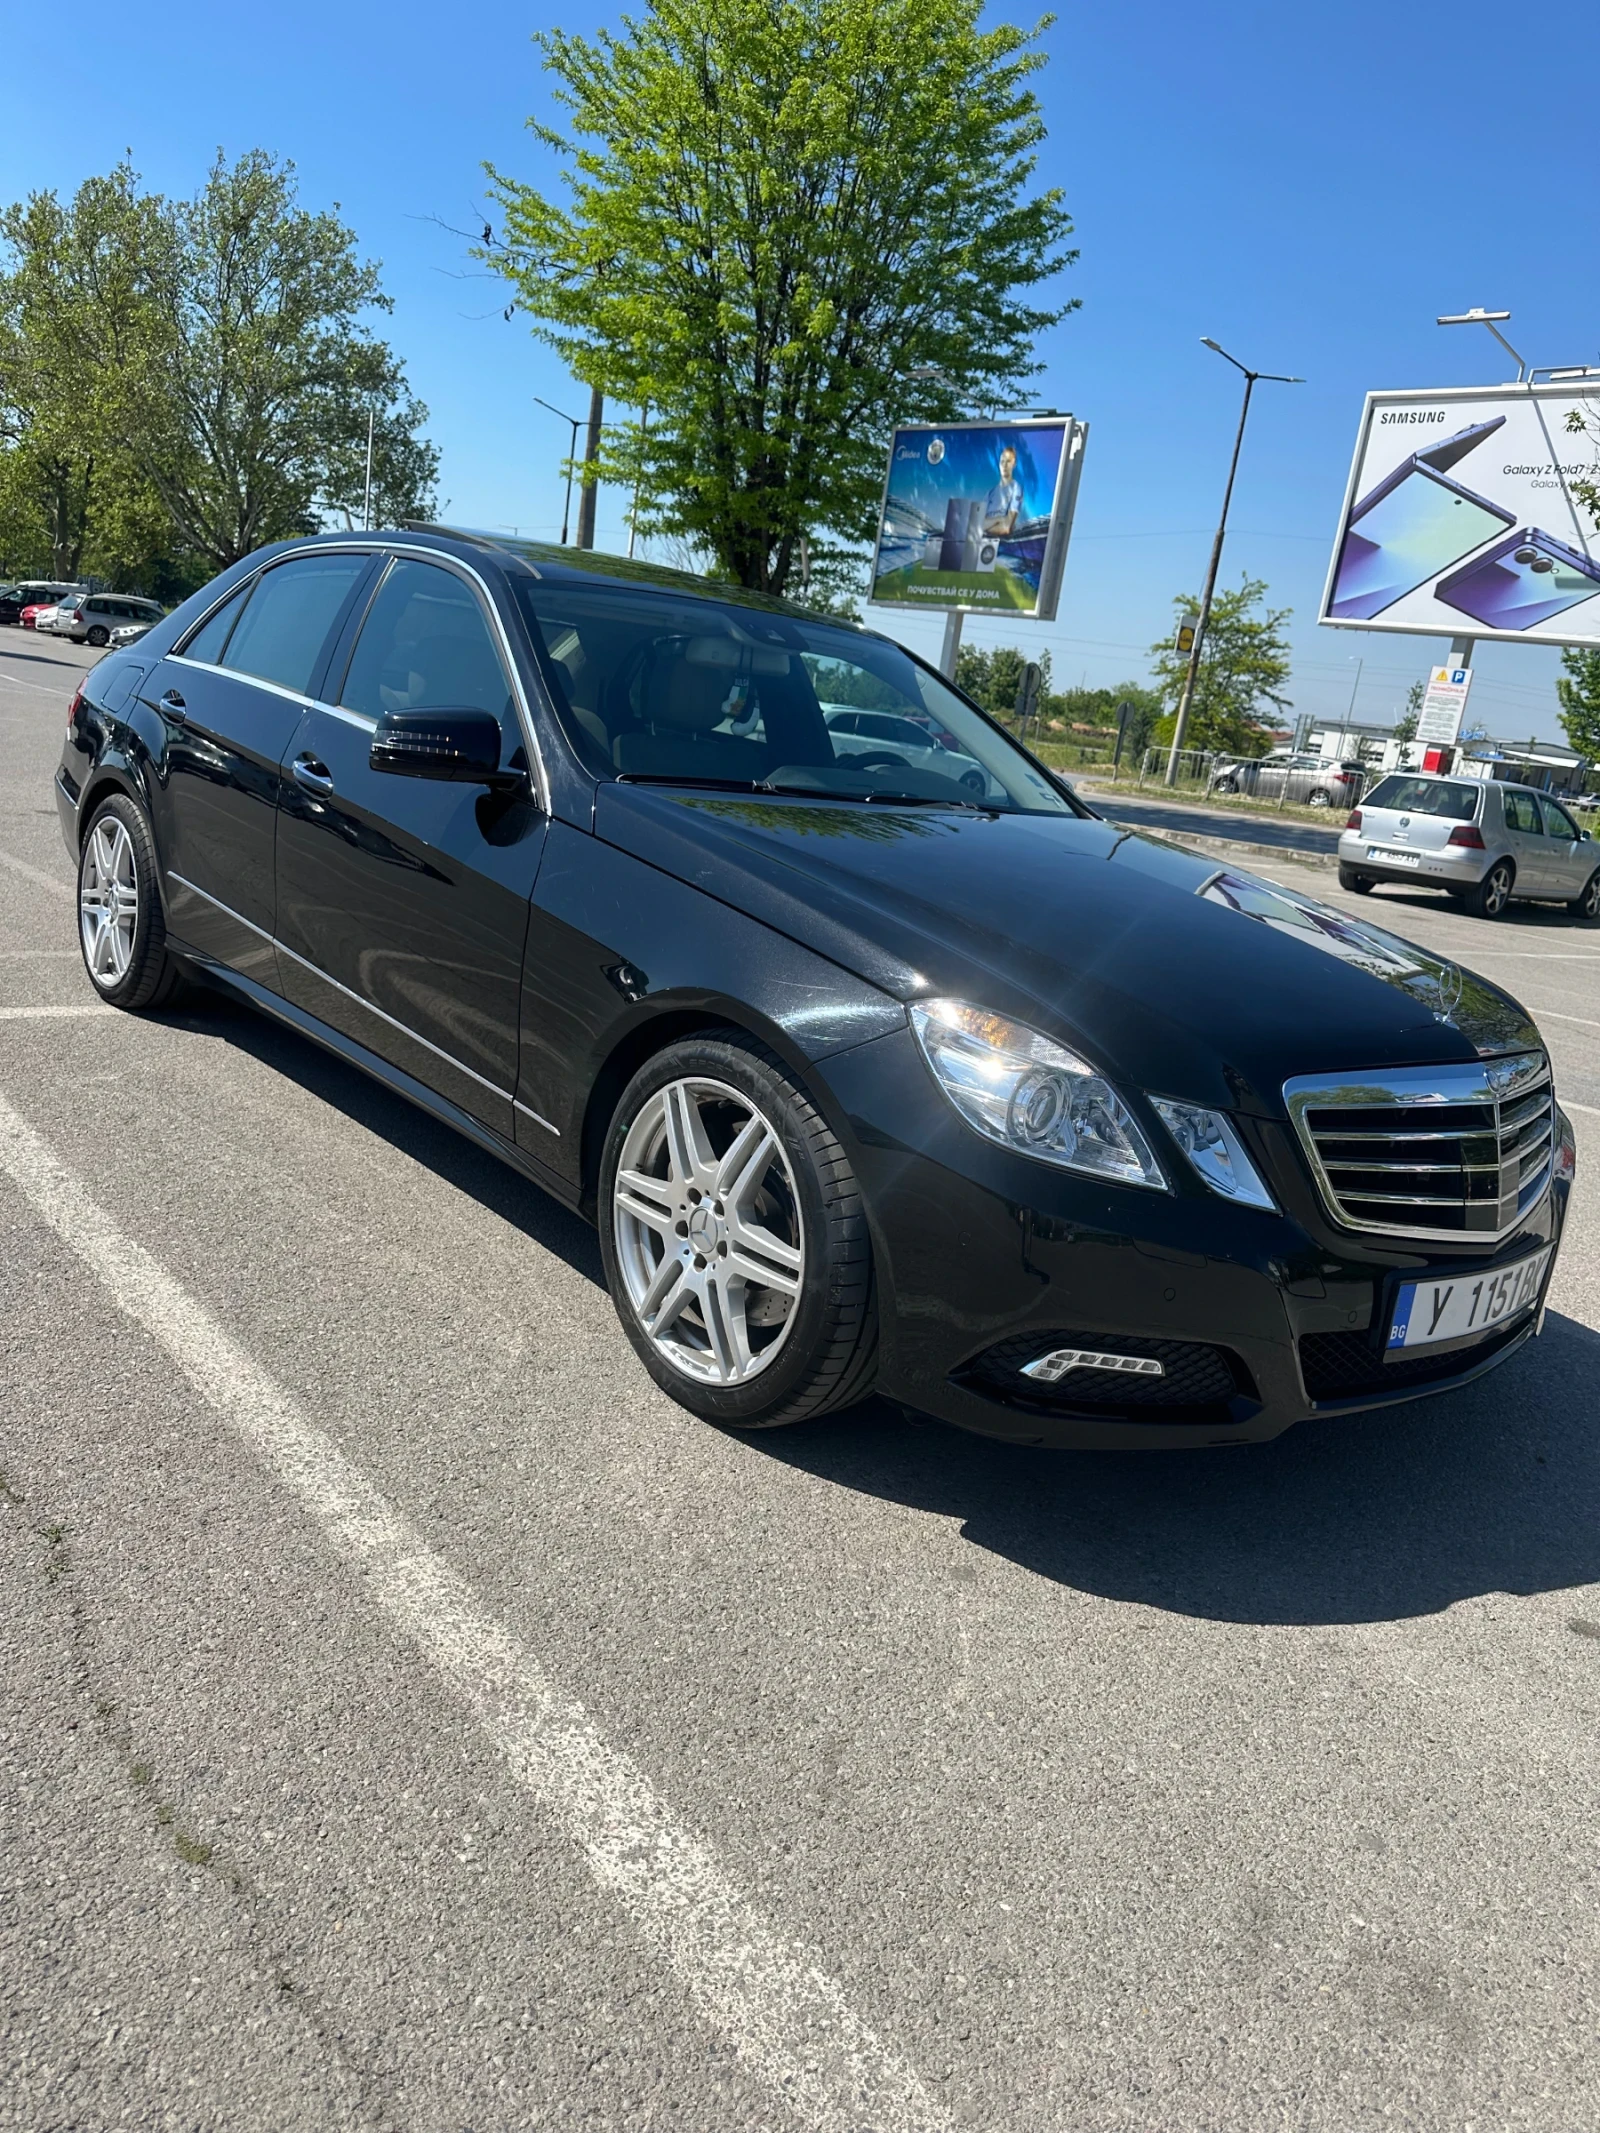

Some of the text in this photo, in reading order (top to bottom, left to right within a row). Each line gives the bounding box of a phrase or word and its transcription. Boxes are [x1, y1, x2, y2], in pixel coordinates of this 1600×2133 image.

[1380, 411, 1446, 425] SAMSUNG
[1502, 464, 1544, 477] Galaxy
[1544, 464, 1553, 475] Z
[1553, 464, 1586, 475] Fold7
[907, 584, 957, 597] ПОЧУВСТВАЙ
[975, 589, 1000, 600] ДОМА
[1390, 1324, 1406, 1340] BG
